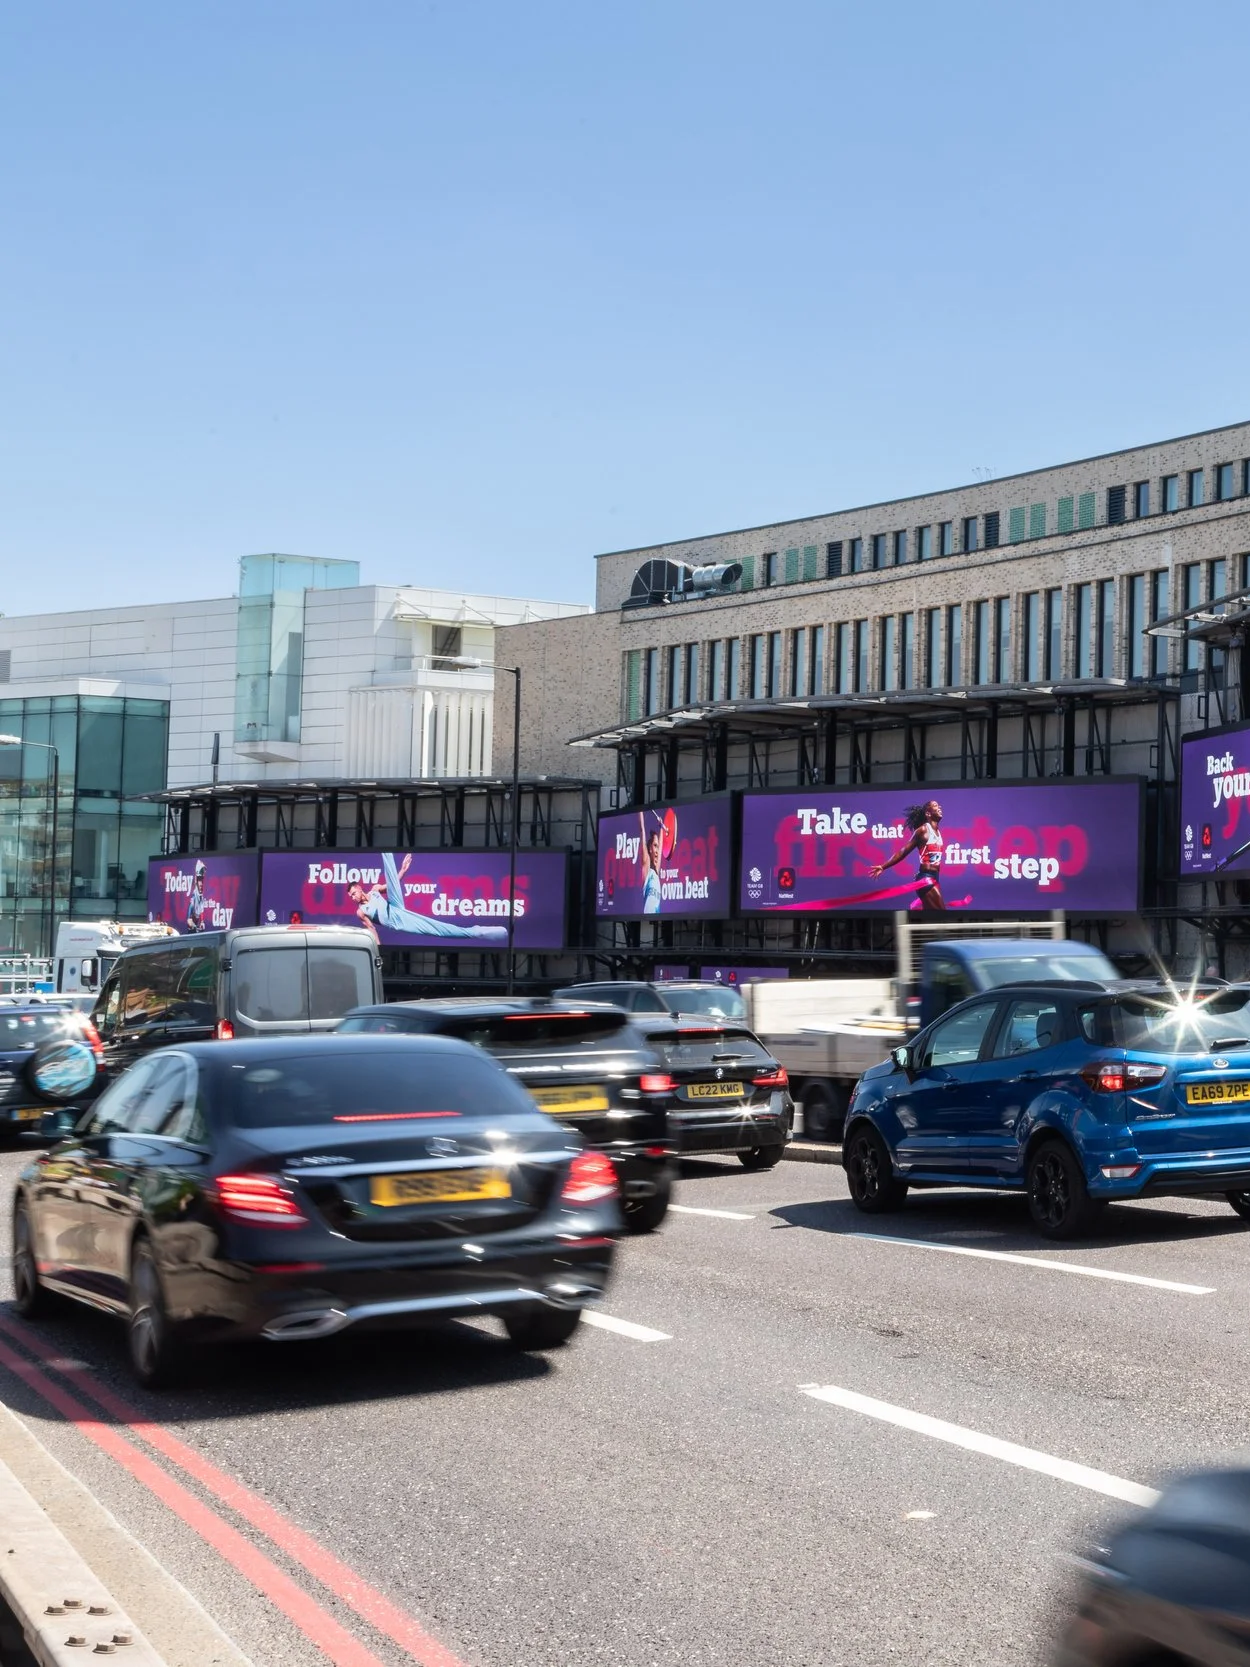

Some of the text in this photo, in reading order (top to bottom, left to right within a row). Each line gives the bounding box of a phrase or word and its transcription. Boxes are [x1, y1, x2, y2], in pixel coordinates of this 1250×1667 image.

[1207, 752, 1234, 775] Back
[797, 807, 904, 838] Take that
[615, 833, 639, 864] Play
[308, 863, 381, 884] Follow
[944, 843, 1060, 885] first step
[165, 871, 193, 896] Today
[404, 883, 437, 896] your
[662, 876, 709, 900] own beat
[213, 902, 234, 930] day
[432, 893, 525, 917] dreams
[692, 1083, 740, 1097] LC22 KMG
[1192, 1083, 1250, 1101] EA69 ZPE
